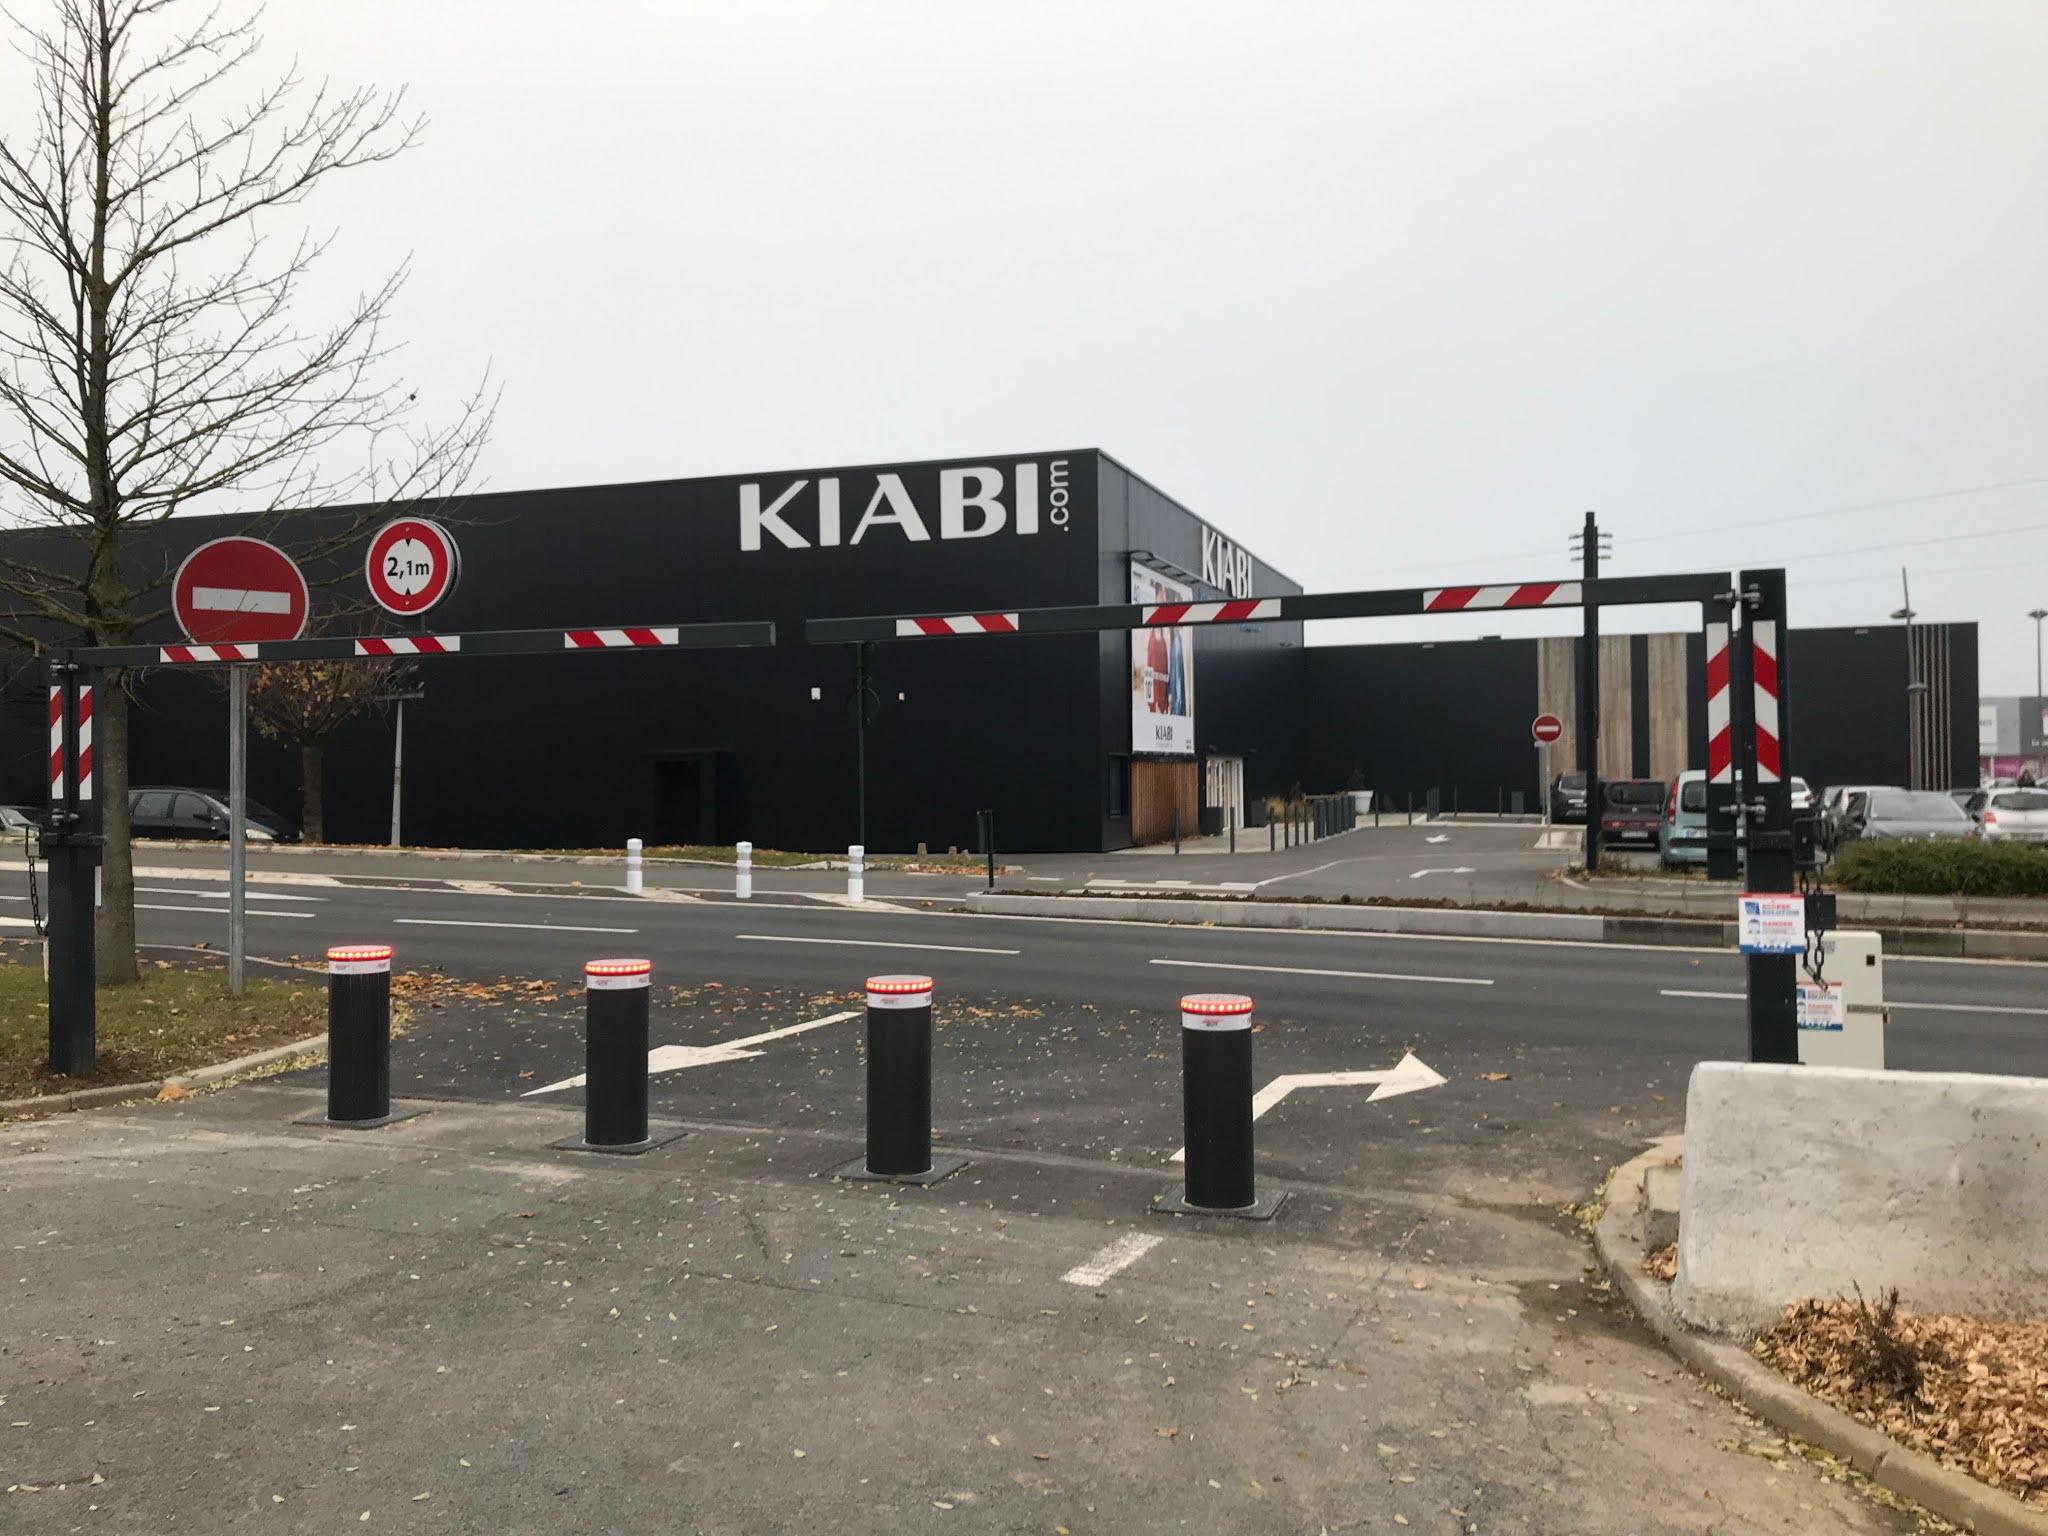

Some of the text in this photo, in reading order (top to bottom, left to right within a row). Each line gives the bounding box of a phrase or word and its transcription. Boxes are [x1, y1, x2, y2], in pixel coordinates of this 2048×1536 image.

[739, 463, 1039, 552] KIABI
[1050, 459, 1069, 532] .com
[387, 556, 430, 579] 2,1m
[1201, 524, 1253, 599] KIABI
[1155, 725, 1173, 741] KIABI
